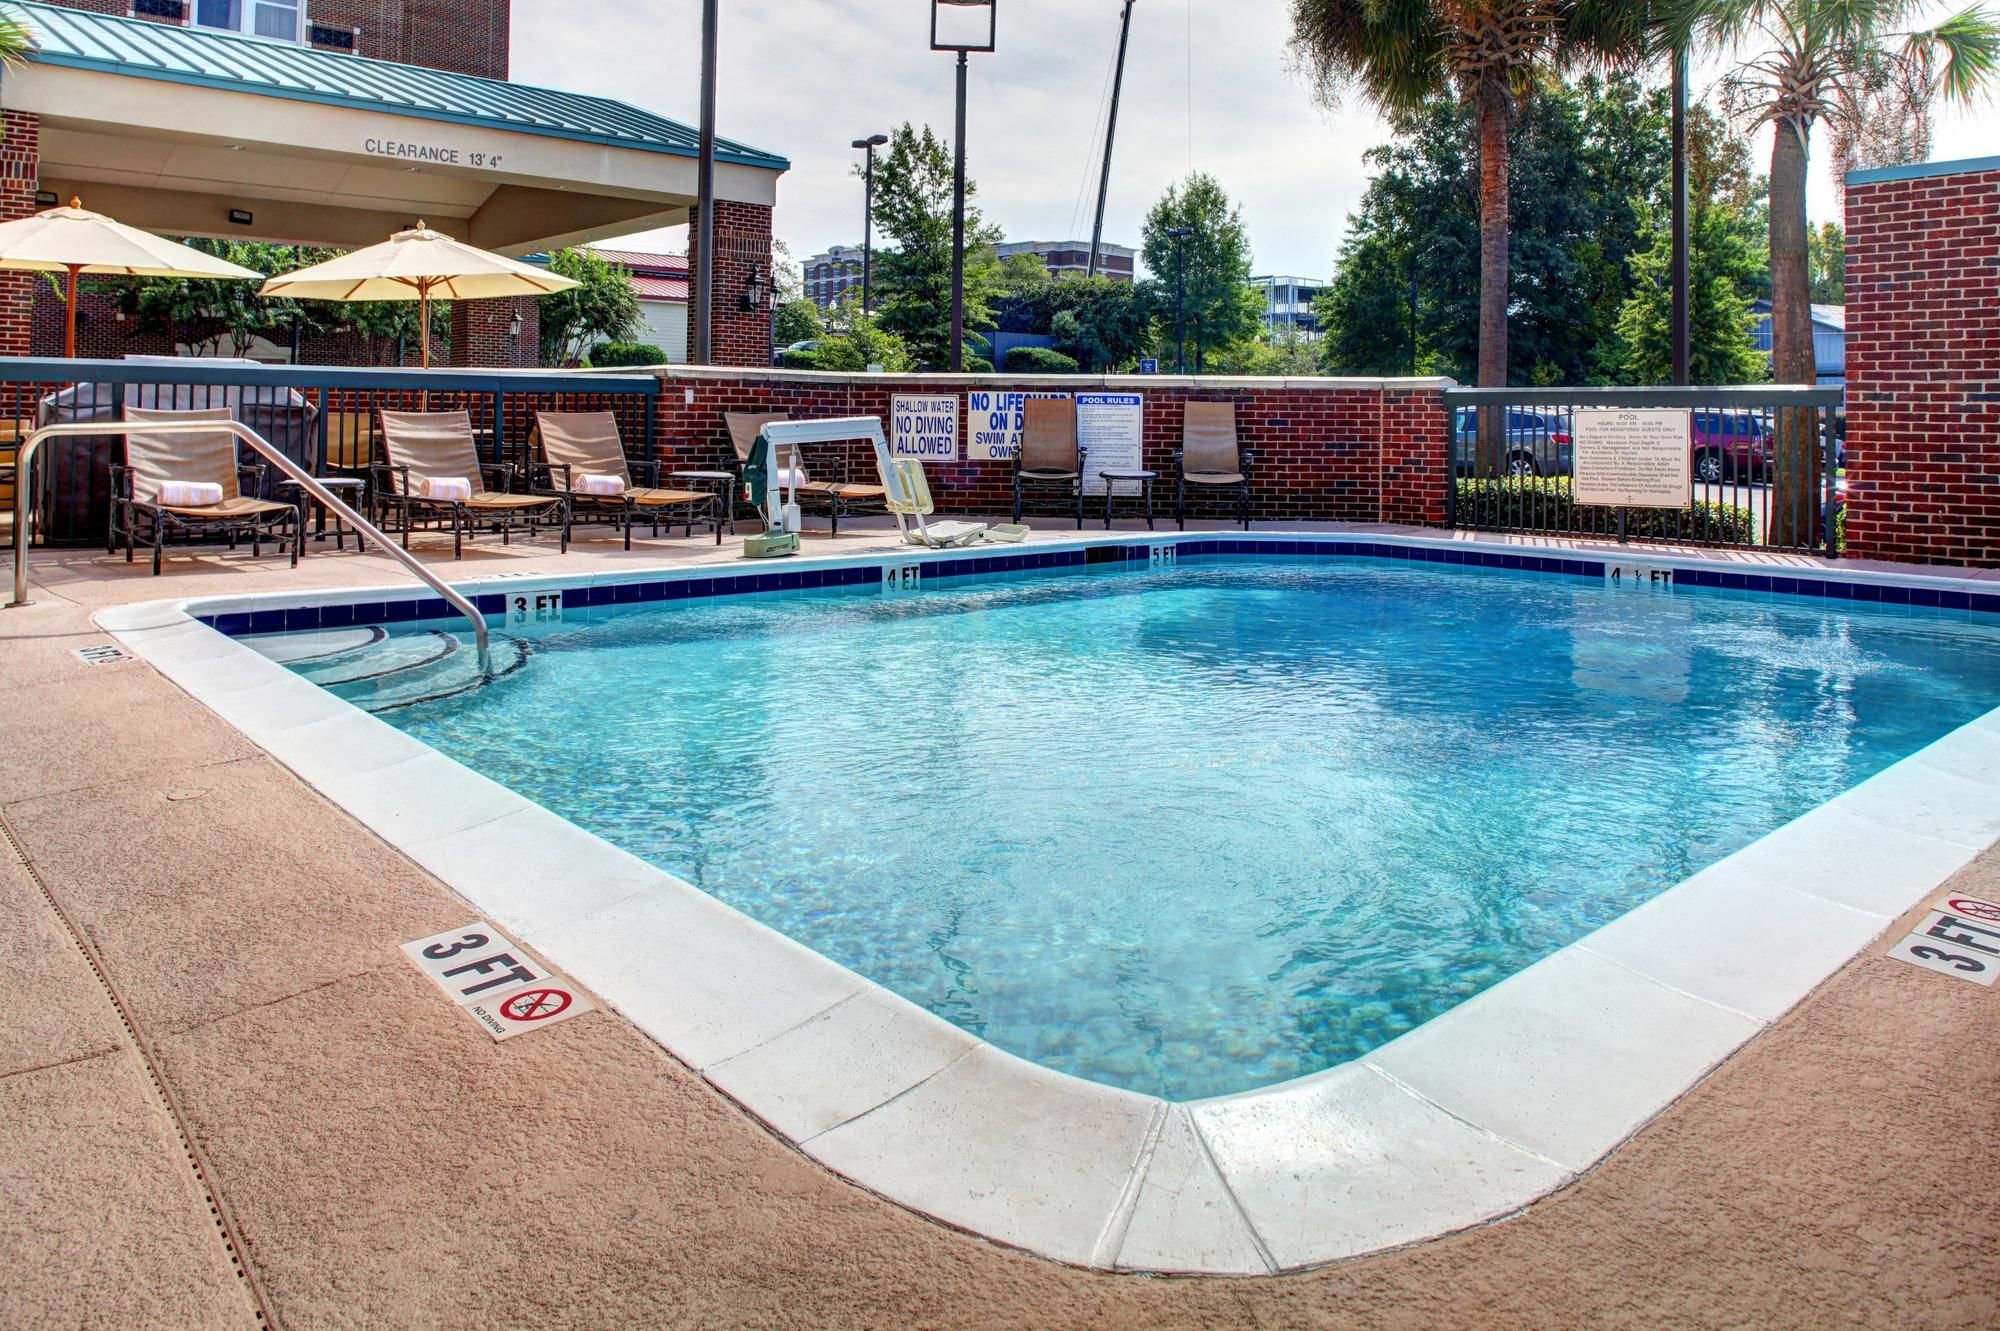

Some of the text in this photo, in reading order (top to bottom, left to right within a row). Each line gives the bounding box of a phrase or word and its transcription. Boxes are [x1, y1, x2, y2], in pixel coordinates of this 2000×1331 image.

[366, 139, 458, 163] CLEARANCE
[469, 153, 485, 166] 13'
[896, 400, 954, 413] SHALLOW WATER
[971, 393, 989, 411] NO
[896, 416, 953, 434] NO DIVING
[990, 412, 1007, 430] ON
[897, 436, 951, 454] ALLOWED
[976, 432, 1004, 444] SWIM
[1153, 546, 1175, 560] 5 FT
[888, 566, 919, 580] 4 FT
[1651, 570, 1671, 582] FT
[514, 594, 560, 611] 3 FT
[1910, 915, 2000, 972] 3 FT
[423, 933, 538, 996] 3 FT
[472, 1006, 506, 1034] NO DIVING
